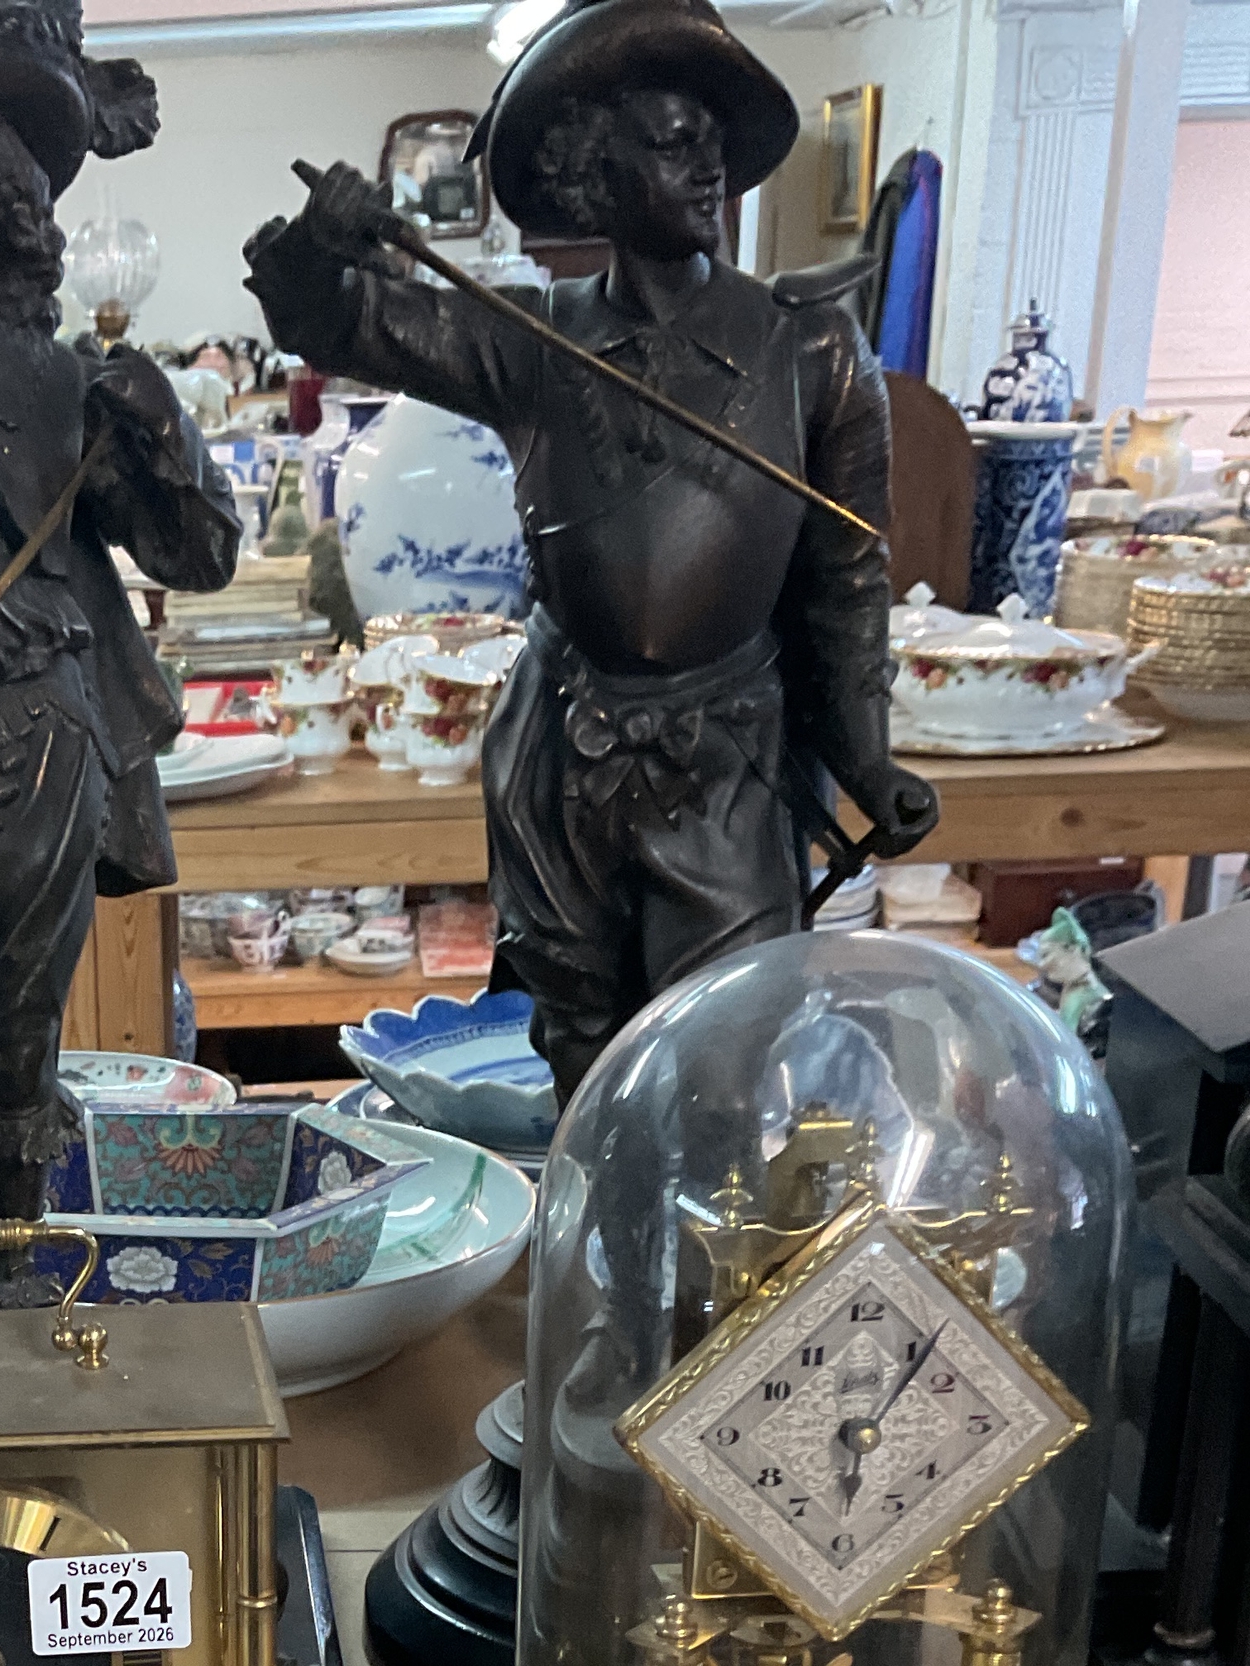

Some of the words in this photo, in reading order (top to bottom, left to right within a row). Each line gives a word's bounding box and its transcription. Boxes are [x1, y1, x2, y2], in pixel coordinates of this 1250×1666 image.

[850, 1301, 886, 1322] 12
[800, 1346, 824, 1366] 11
[906, 1340, 917, 1362] 1
[762, 1380, 792, 1401] 10
[930, 1373, 955, 1394] 2
[966, 1414, 993, 1435] 3
[716, 1426, 740, 1446] 9
[757, 1467, 783, 1488] 8
[915, 1461, 941, 1480] 4
[789, 1496, 811, 1518] 7
[880, 1494, 905, 1514] 5
[39, 1517, 61, 1551] I
[831, 1534, 854, 1554] 6
[67, 1558, 148, 1577] Stacey's
[49, 1577, 173, 1630] 1524
[48, 1631, 133, 1649] September
[138, 1627, 174, 1643] 2026
